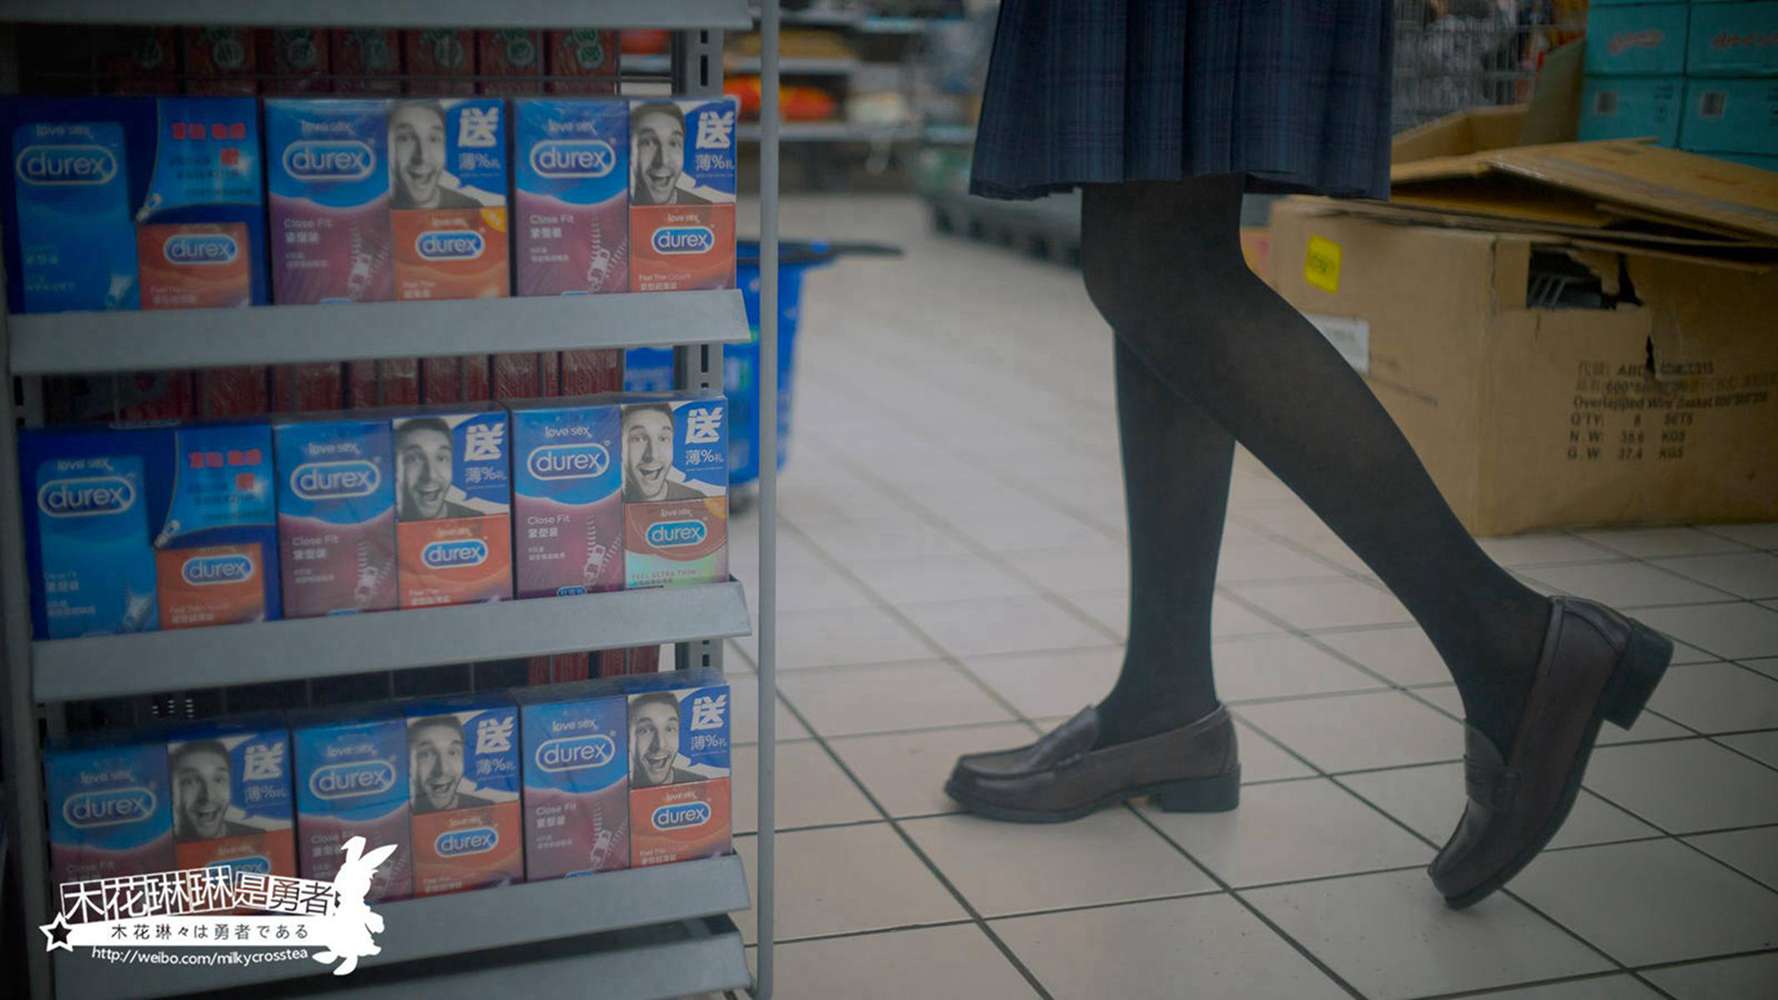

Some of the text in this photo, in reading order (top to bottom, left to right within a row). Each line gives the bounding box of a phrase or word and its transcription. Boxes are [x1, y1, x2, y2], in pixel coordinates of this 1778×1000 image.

[458, 107, 500, 148] 送
[695, 110, 735, 149] 送
[27, 152, 107, 177] durex
[292, 147, 364, 171] durex
[540, 146, 607, 170] durex
[170, 240, 232, 259] durex
[421, 236, 478, 254] durex
[657, 230, 709, 250] durex
[544, 427, 569, 438] love
[685, 407, 722, 444] 送
[464, 422, 504, 462] 送
[536, 451, 602, 472] durex
[300, 469, 371, 492] durex
[48, 483, 127, 509] durex
[527, 514, 570, 525] Close Fit
[651, 525, 704, 543] durex
[428, 544, 483, 562] durex
[189, 559, 247, 579] durex
[690, 694, 727, 731] 送
[475, 716, 514, 755] 送
[552, 721, 576, 733] love
[544, 743, 607, 765] durex
[319, 769, 390, 791] durex
[74, 797, 150, 820] durex
[658, 808, 705, 826] durex
[440, 833, 493, 852] durex
